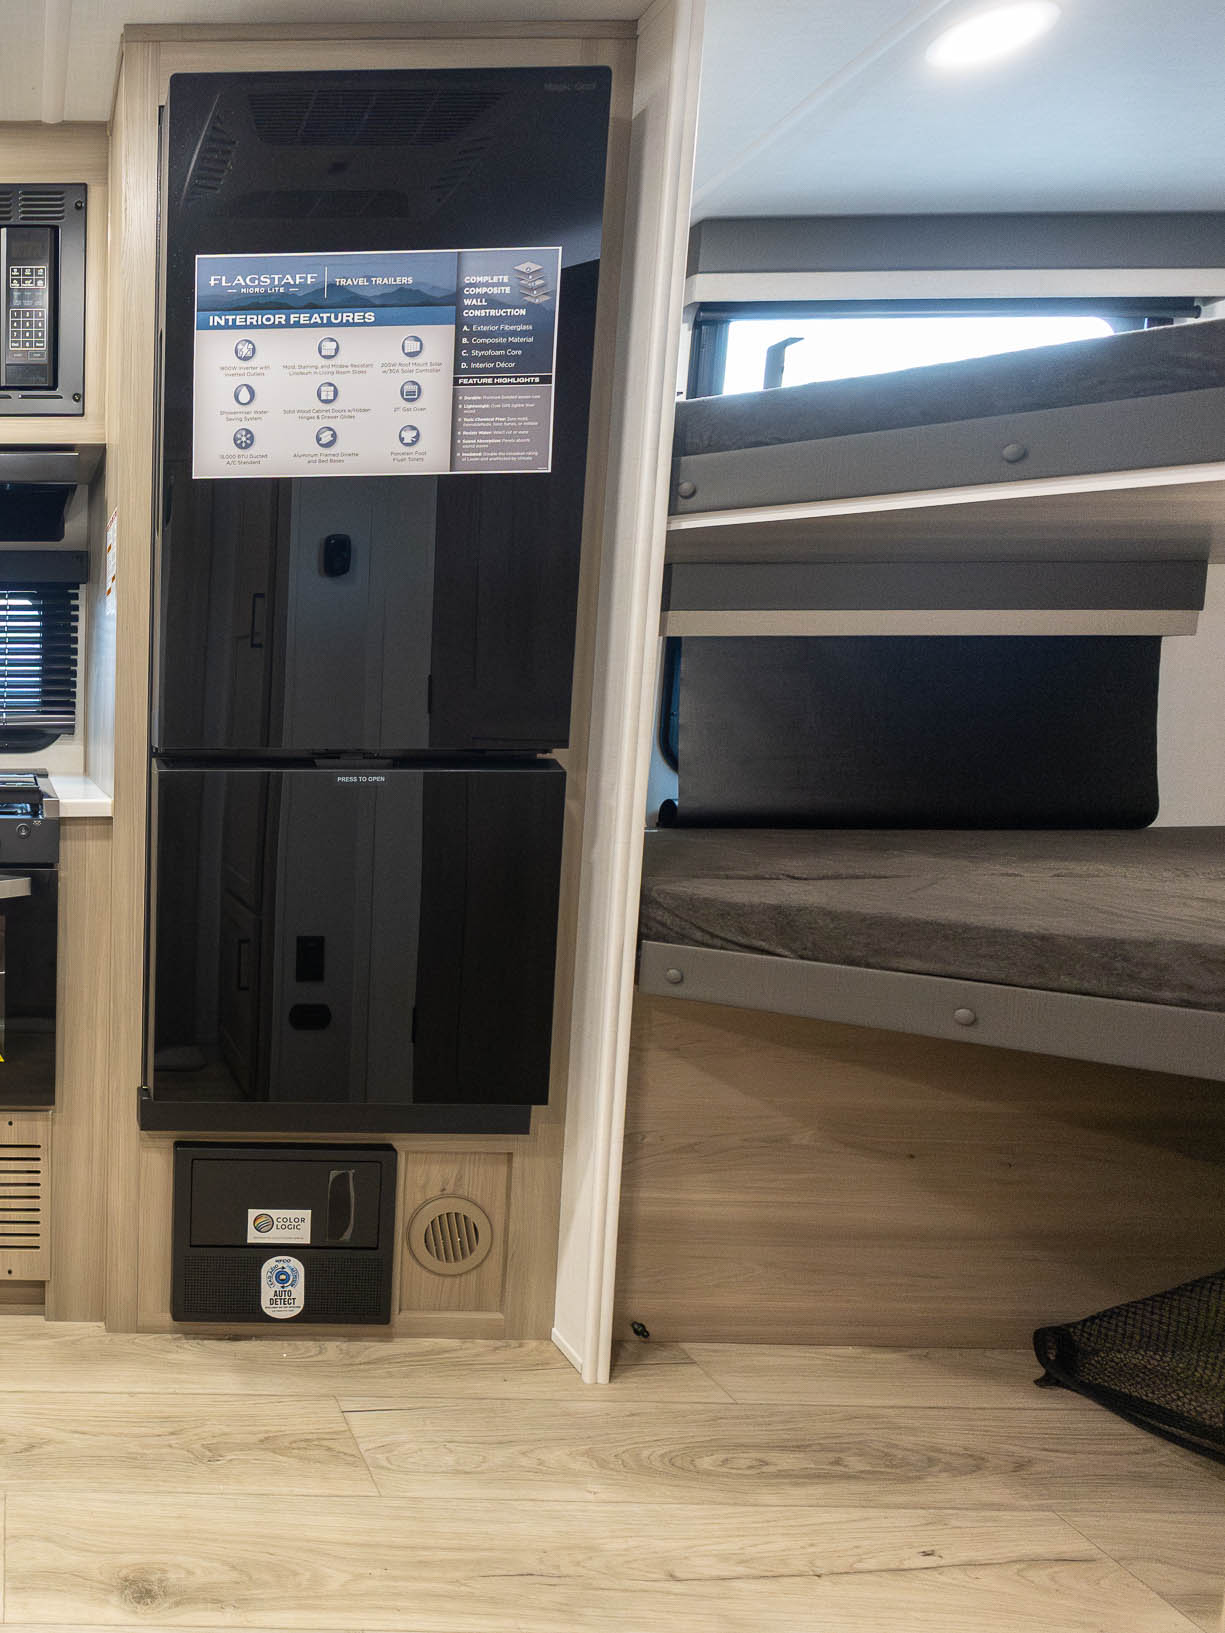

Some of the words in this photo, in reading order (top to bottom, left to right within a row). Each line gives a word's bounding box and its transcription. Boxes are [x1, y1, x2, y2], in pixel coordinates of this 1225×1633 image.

[209, 273, 318, 287] FLAGSTAFF
[335, 277, 369, 287] TRAVEL
[371, 277, 414, 286] TRAILERS
[464, 276, 509, 284] COMPLETE
[463, 287, 511, 295] COMPOSITE
[463, 298, 488, 306] WALL
[463, 309, 527, 317] CONSTRUCTION
[209, 313, 286, 327] INTERIOR
[289, 312, 376, 325] FEATURES
[500, 323, 533, 332] Fiberglass
[472, 337, 507, 345] Composite
[472, 349, 506, 358] Styrofoam
[273, 1290, 292, 1298] AUTO
[269, 1298, 297, 1306] DETECT
